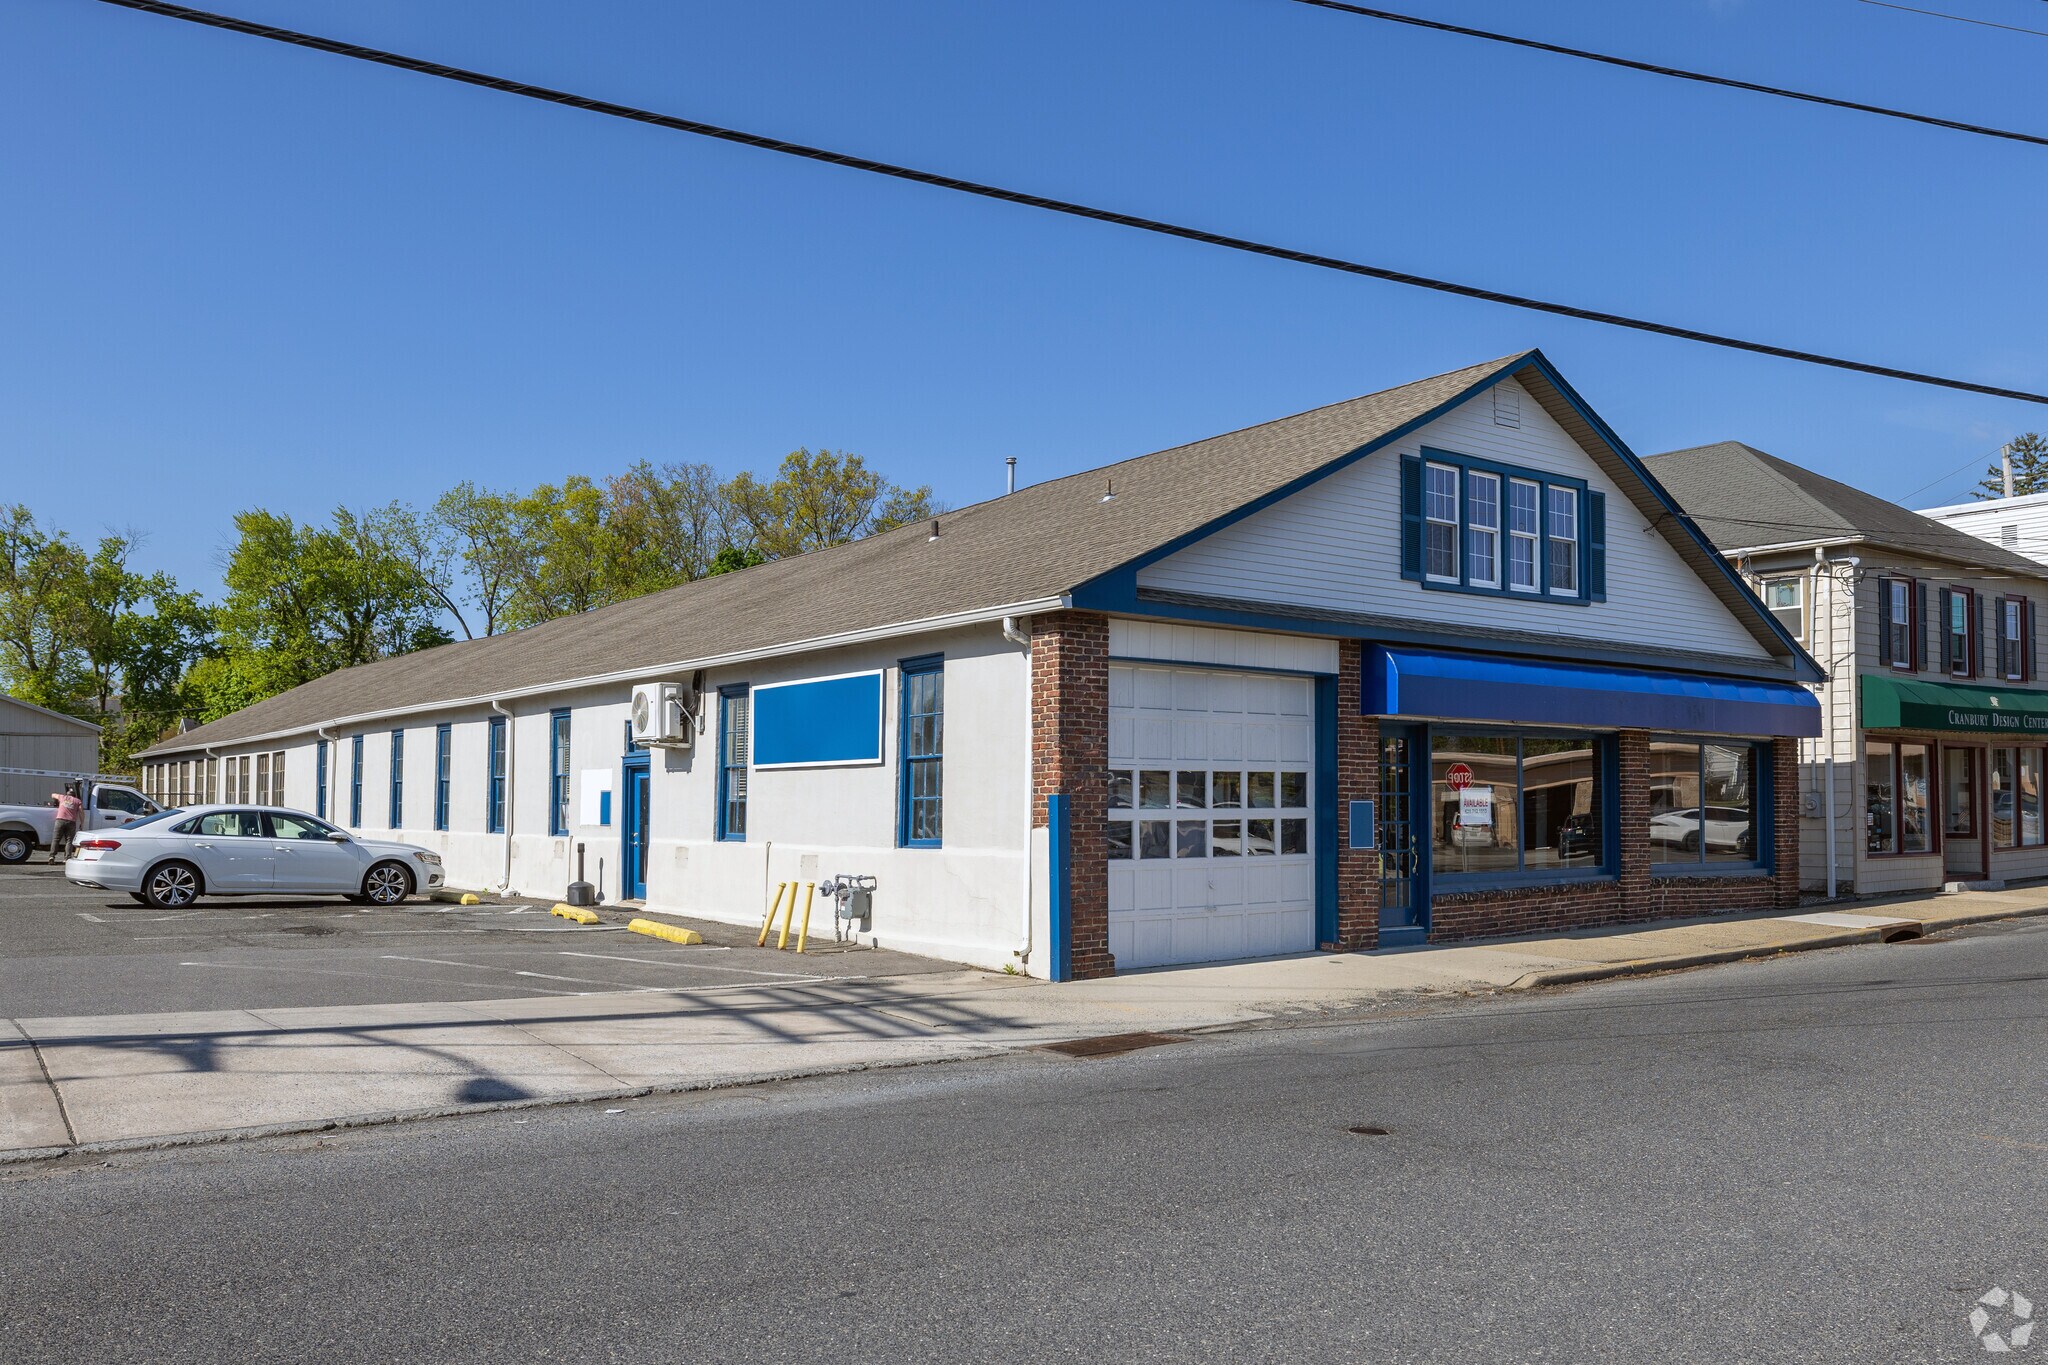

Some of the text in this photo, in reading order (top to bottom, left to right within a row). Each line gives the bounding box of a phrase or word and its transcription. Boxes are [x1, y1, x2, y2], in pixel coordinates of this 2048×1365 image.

[1948, 710, 2048, 728] CRANBURY DESIGN CENTER
[1464, 798, 1488, 807] AVAILABLE
